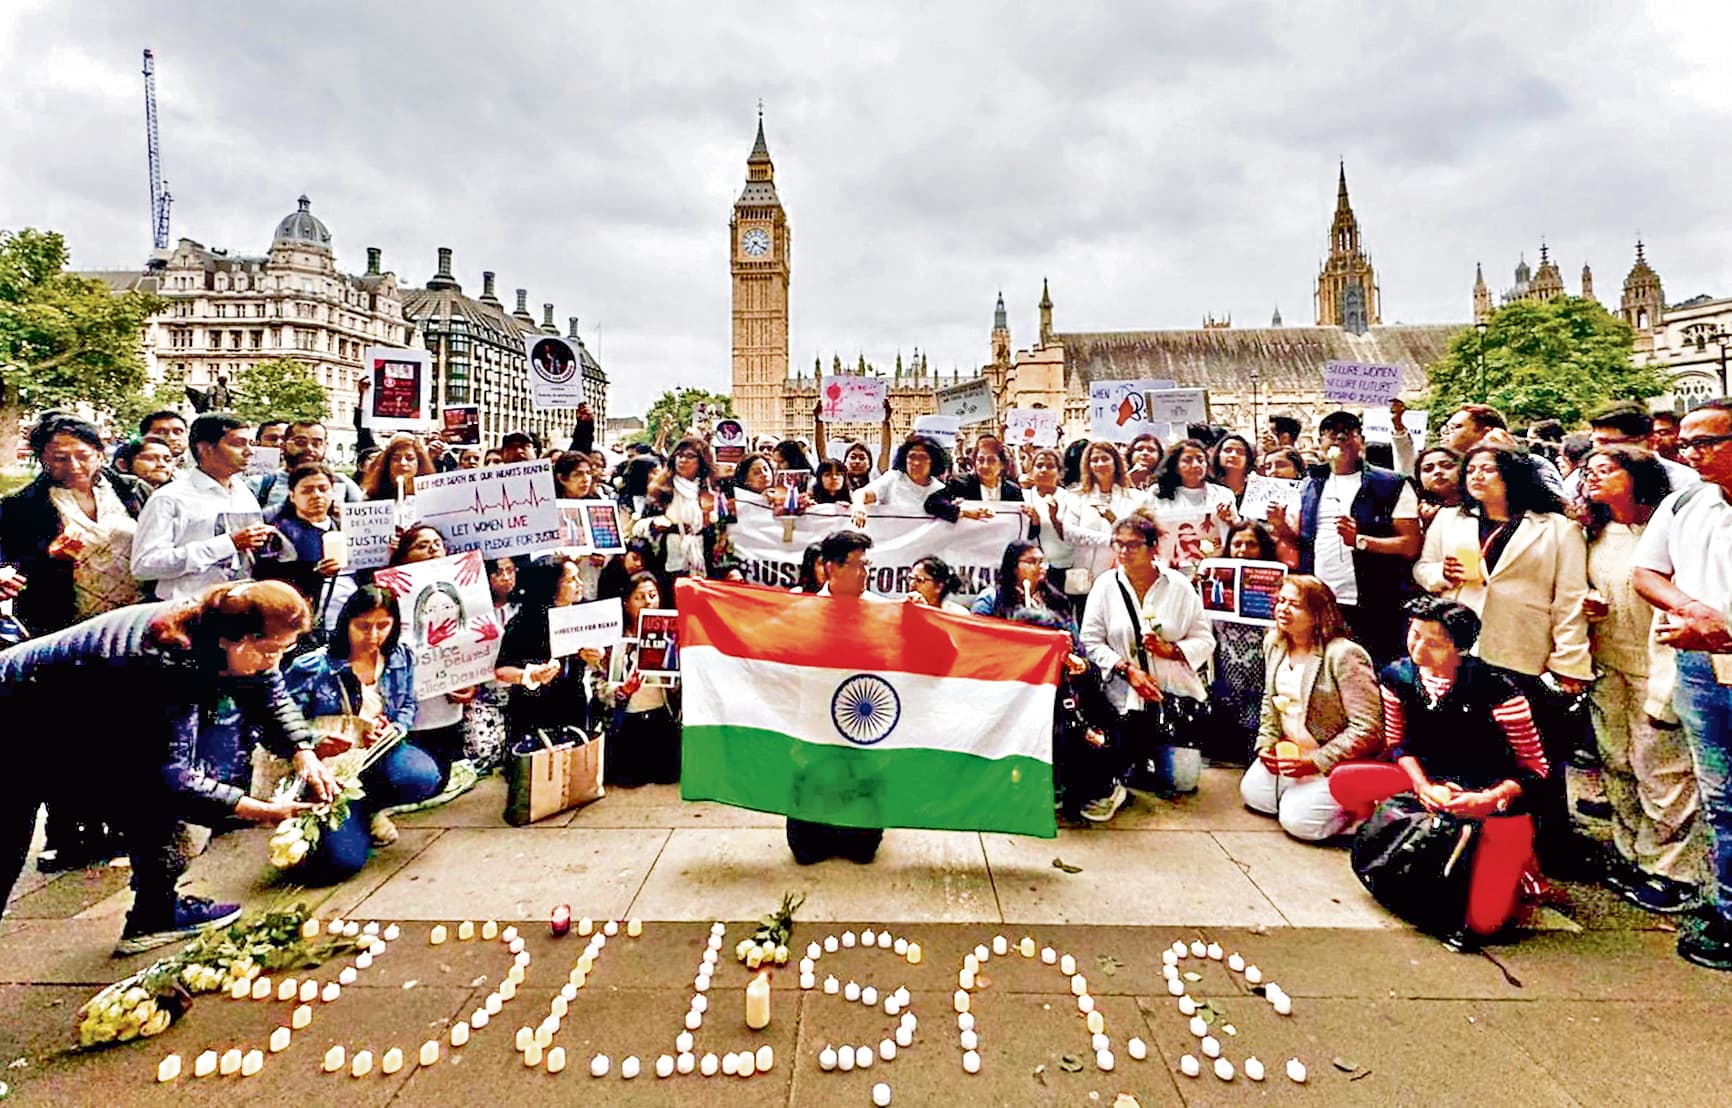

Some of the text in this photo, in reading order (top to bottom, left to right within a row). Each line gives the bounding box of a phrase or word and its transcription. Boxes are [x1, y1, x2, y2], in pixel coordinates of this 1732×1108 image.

[1092, 389, 1110, 400] WHEN
[416, 480, 429, 491] LET
[431, 477, 445, 487] HER
[447, 474, 466, 486] DEATH
[468, 472, 477, 482] BE
[480, 470, 493, 480] OUR
[346, 504, 393, 516] JUSTICE
[451, 515, 528, 537] LET WOMEN LIVE
[485, 536, 514, 550] PLEDGE
[516, 534, 533, 546] FOR
